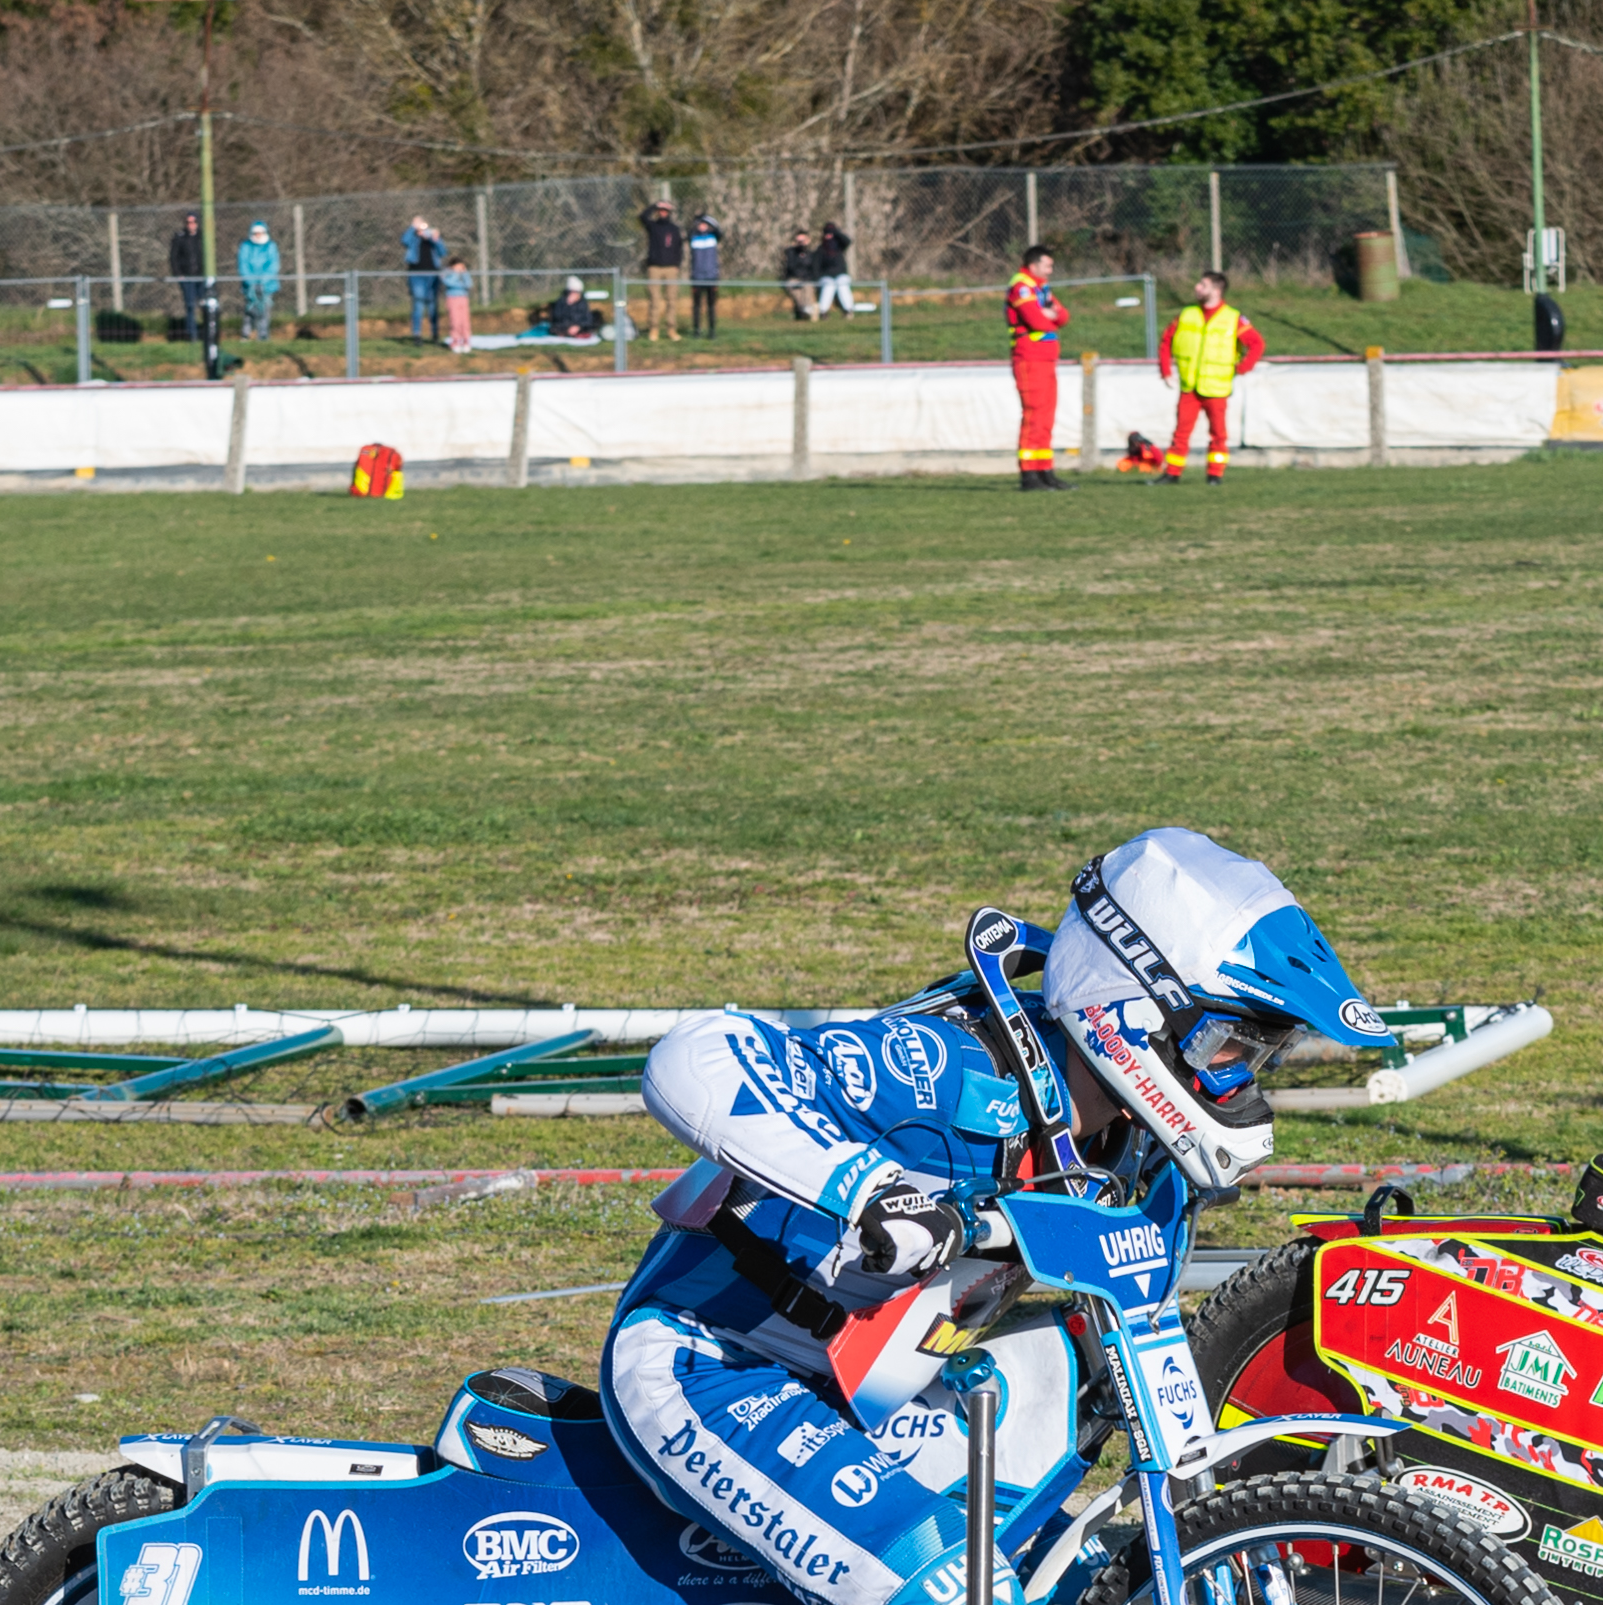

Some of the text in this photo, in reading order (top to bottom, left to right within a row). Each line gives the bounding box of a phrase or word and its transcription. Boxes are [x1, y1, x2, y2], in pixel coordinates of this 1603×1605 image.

[1084, 894, 1195, 1012] WULF
[881, 1016, 938, 1110] MOLLNER
[1084, 1003, 1197, 1135] BLOODY-HARRY
[1098, 1222, 1167, 1267] UHRIG
[1325, 1268, 1412, 1306] 415
[1414, 1333, 1460, 1358] ATELIER
[1384, 1337, 1483, 1390] AUNEAU
[1157, 1378, 1198, 1408] FUCHS
[1503, 1376, 1560, 1407] BATIMENTS
[871, 1413, 947, 1440] UCHS
[1295, 1412, 1343, 1421] LAYER
[1412, 1473, 1474, 1498] RMA
[657, 1419, 853, 1588] Peterstaler
[474, 1529, 568, 1561] BMC
[476, 1559, 563, 1580] Air Filter
[677, 1572, 709, 1587] there
[712, 1574, 724, 1585] is
[298, 1585, 371, 1596] mcd-timme.de
